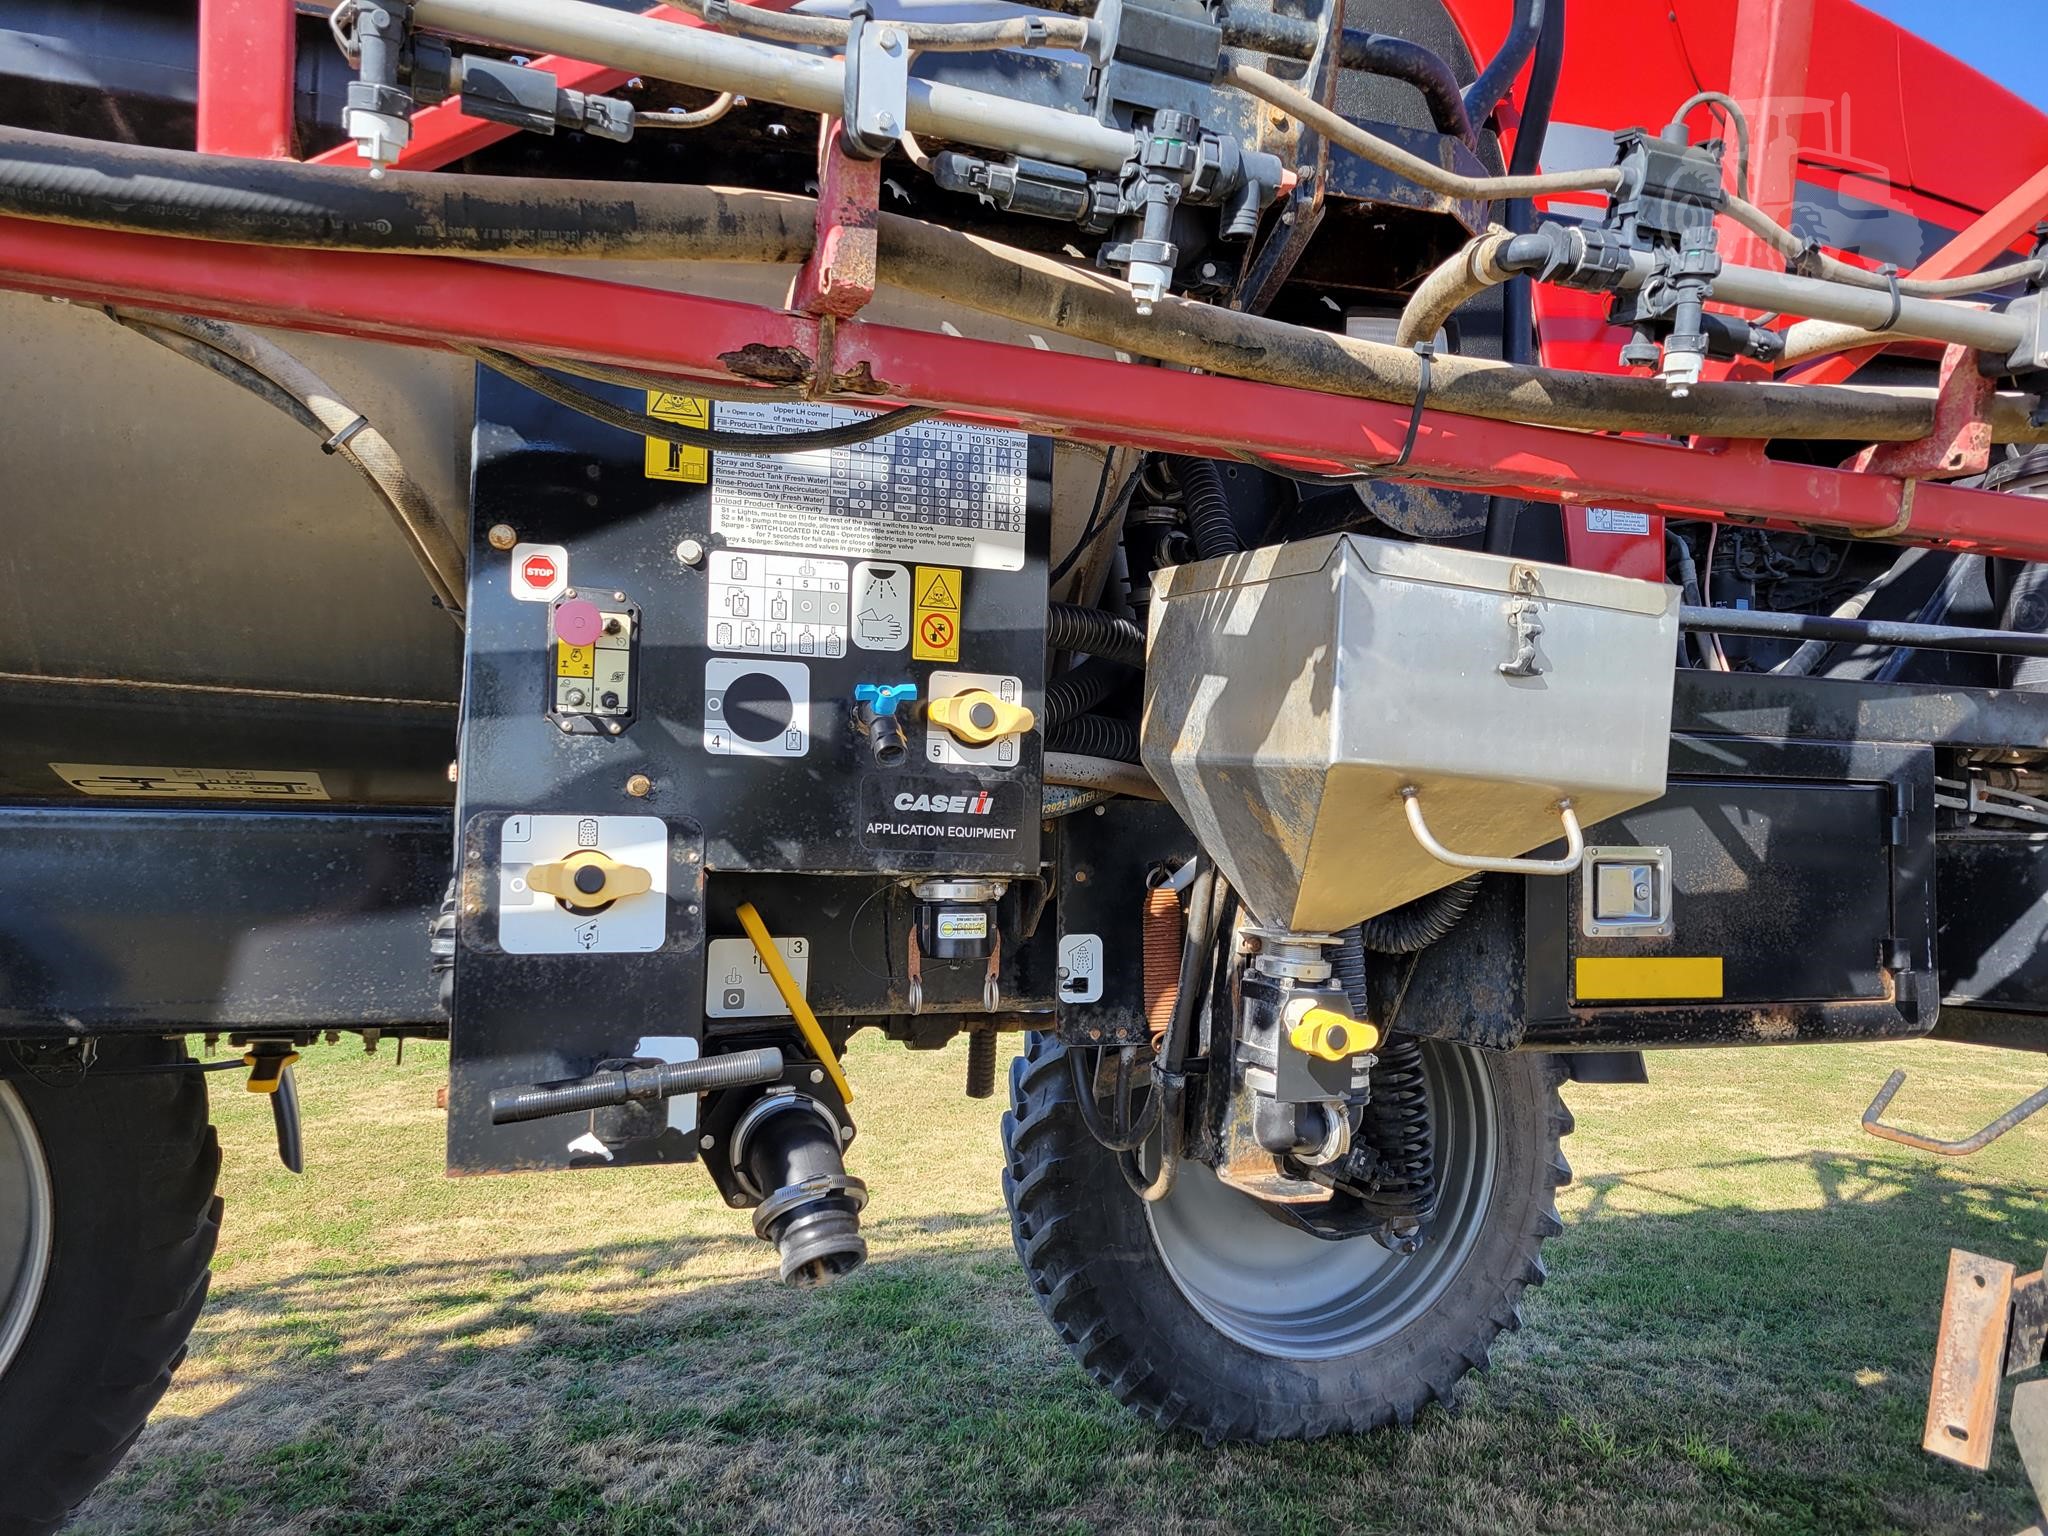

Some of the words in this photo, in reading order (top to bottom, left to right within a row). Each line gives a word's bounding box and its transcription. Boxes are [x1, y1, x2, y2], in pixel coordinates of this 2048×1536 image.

[773, 405, 795, 415] Upper
[807, 410, 829, 418] corner
[853, 410, 877, 418] VALV
[717, 419, 757, 429] Fill-Product
[759, 423, 775, 431] Tank
[986, 437, 995, 445] S1
[998, 439, 1009, 447] S2
[716, 458, 737, 467] Spray
[756, 462, 783, 471] Sparge
[716, 468, 765, 478] Rinse-Product
[767, 472, 783, 480] Tank
[784, 474, 805, 482] (Fresh
[807, 476, 829, 485] Water)
[715, 478, 763, 488] Rinse-Product
[765, 482, 780, 490] Tank
[782, 484, 829, 496] (Recirculation)
[715, 487, 761, 497] Rinse-Booms
[763, 491, 779, 500] Only
[780, 493, 801, 501] (Fresh
[803, 496, 825, 504] Water)
[715, 496, 742, 505] Unload
[744, 499, 774, 508] Product
[776, 502, 822, 514] Tank-Gravity
[721, 521, 745, 529] Sparge
[750, 523, 778, 531] SWITCH
[779, 526, 811, 534] LOCATED
[841, 531, 871, 539] Operates
[872, 534, 895, 542] electric
[896, 537, 918, 545] sparge
[952, 541, 972, 549] switch
[772, 533, 800, 541] seconds
[875, 542, 897, 550] sparge
[748, 537, 773, 546] Sparge:
[774, 540, 804, 548] Switches
[526, 567, 553, 578] STOP
[803, 580, 809, 588] 5
[829, 582, 840, 590] 10
[712, 735, 721, 748] 4
[933, 745, 941, 757] 5
[894, 792, 966, 813] CASE
[1069, 790, 1096, 807] WATER
[513, 822, 521, 834] 1
[866, 823, 945, 837] APPLICATION
[947, 826, 1016, 840] EQUIPMENT
[793, 941, 803, 954] 3
